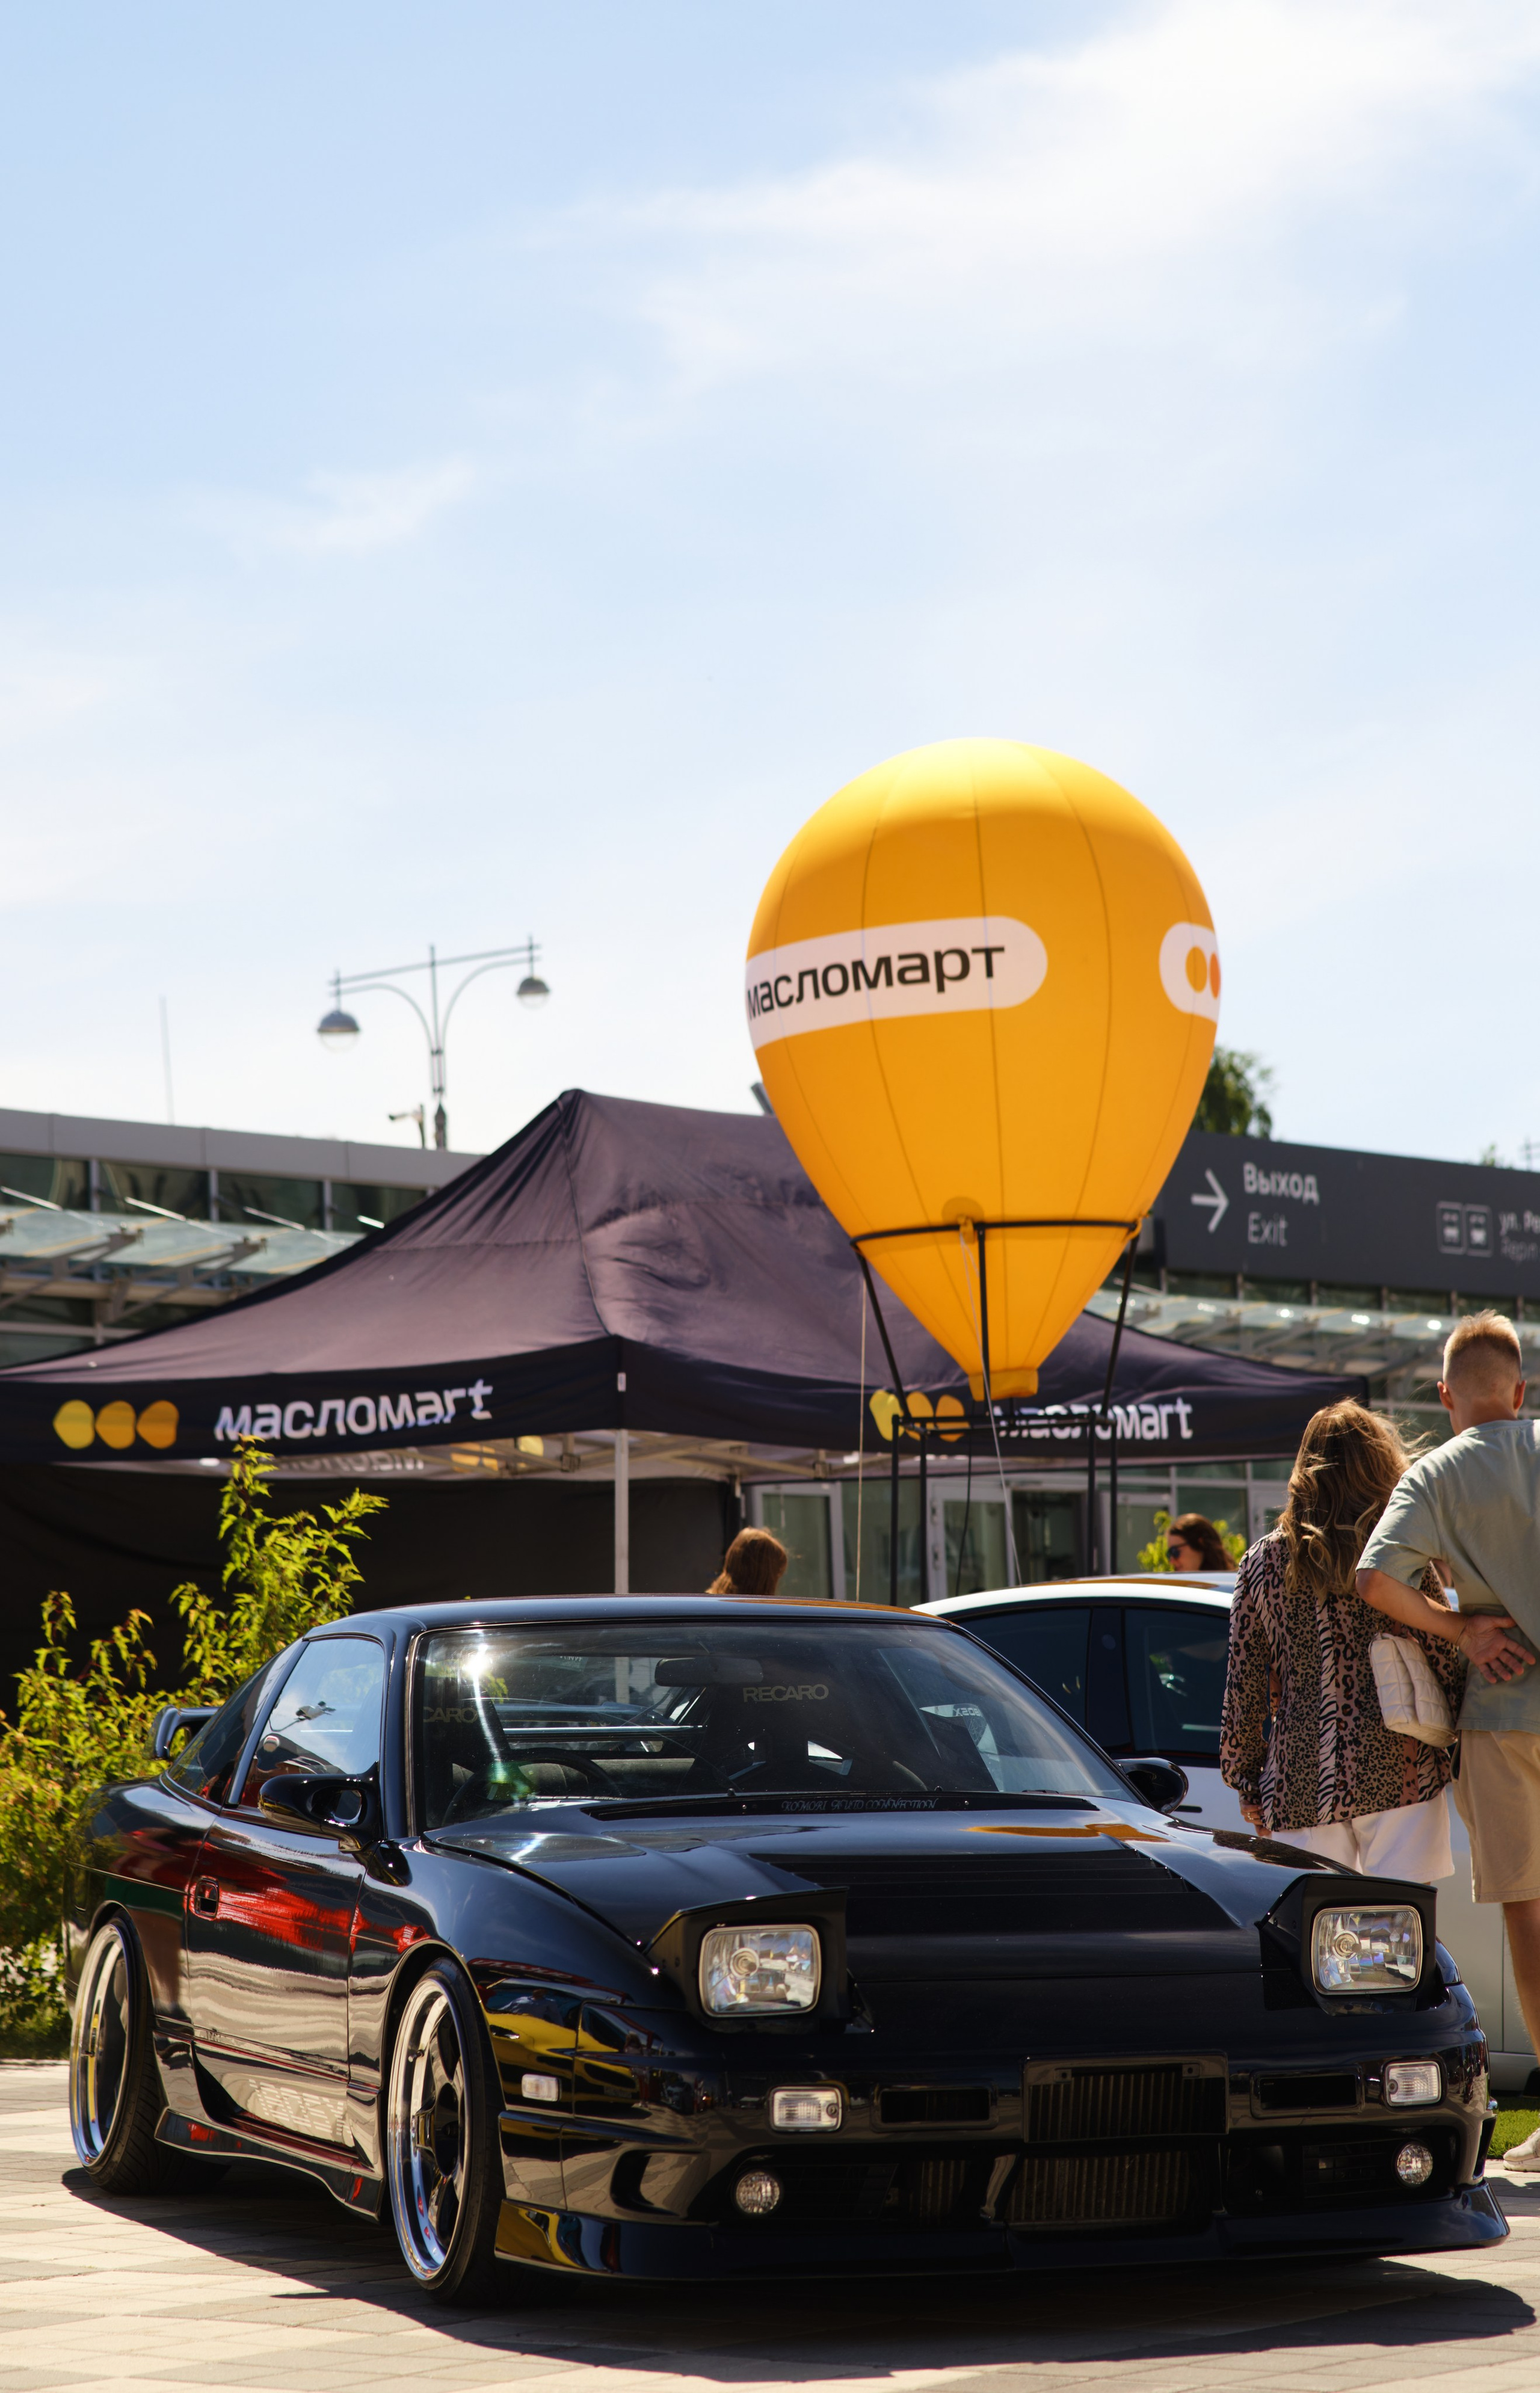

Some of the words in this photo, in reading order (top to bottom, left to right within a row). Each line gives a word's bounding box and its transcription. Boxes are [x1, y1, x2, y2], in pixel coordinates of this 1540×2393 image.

[747, 946, 1006, 1021] масломарт
[1243, 1162, 1319, 1205] Выход
[1248, 1211, 1287, 1246] Exit
[742, 1684, 829, 1702] RECARO
